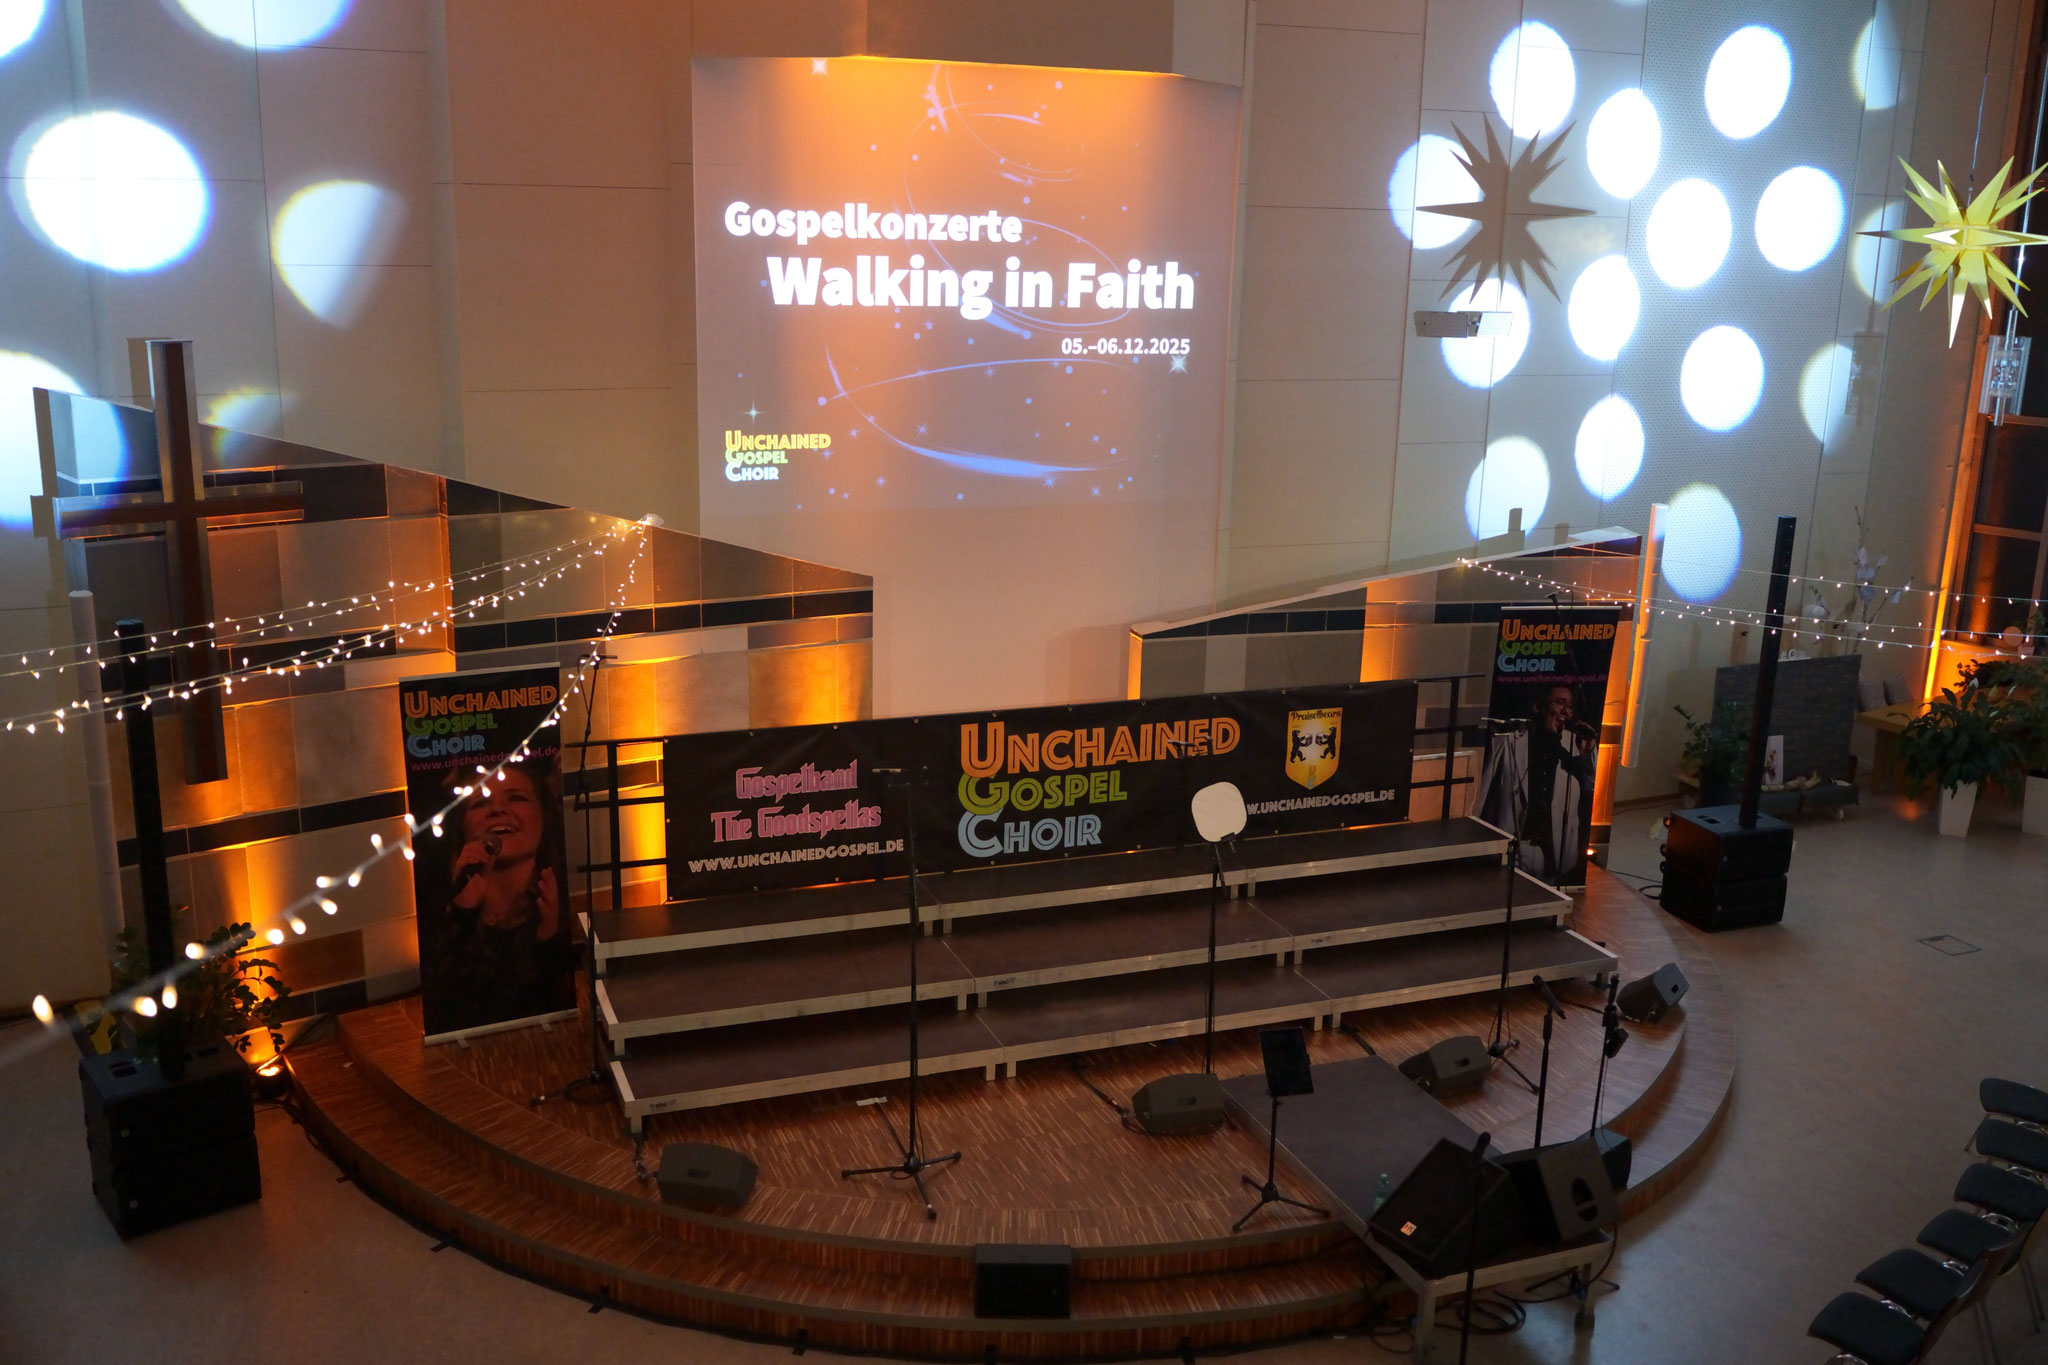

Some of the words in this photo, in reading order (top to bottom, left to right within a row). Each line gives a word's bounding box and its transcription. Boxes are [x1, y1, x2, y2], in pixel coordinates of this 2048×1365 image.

[724, 201, 1023, 245] Gospelkonzerte
[766, 253, 994, 320] Walking
[1005, 255, 1053, 309] in
[1066, 257, 1195, 310] Faith
[725, 430, 832, 451] UNCHAINED
[725, 448, 788, 465] GOSPEL
[725, 462, 779, 482] CHOIR
[1501, 619, 1615, 641] UNCHAINED
[1500, 638, 1567, 655] GOSPEL
[1497, 653, 1556, 673] CHOIR
[404, 685, 557, 718] UNCHAINED
[405, 713, 498, 736] GOSPEL
[407, 734, 485, 758] CHOIR
[960, 717, 1241, 778] UNCHAINED
[736, 758, 858, 804] Gospelband
[958, 770, 1128, 816] GOSPEL
[1246, 789, 1395, 816] W.UNCHAINEDGOSPEL.DE
[710, 810, 752, 843] The
[757, 799, 882, 840] Goodspellas
[957, 809, 1102, 858] CHOIR
[688, 838, 905, 873] WWW.UNCHAINEDGOSPEL.DE
